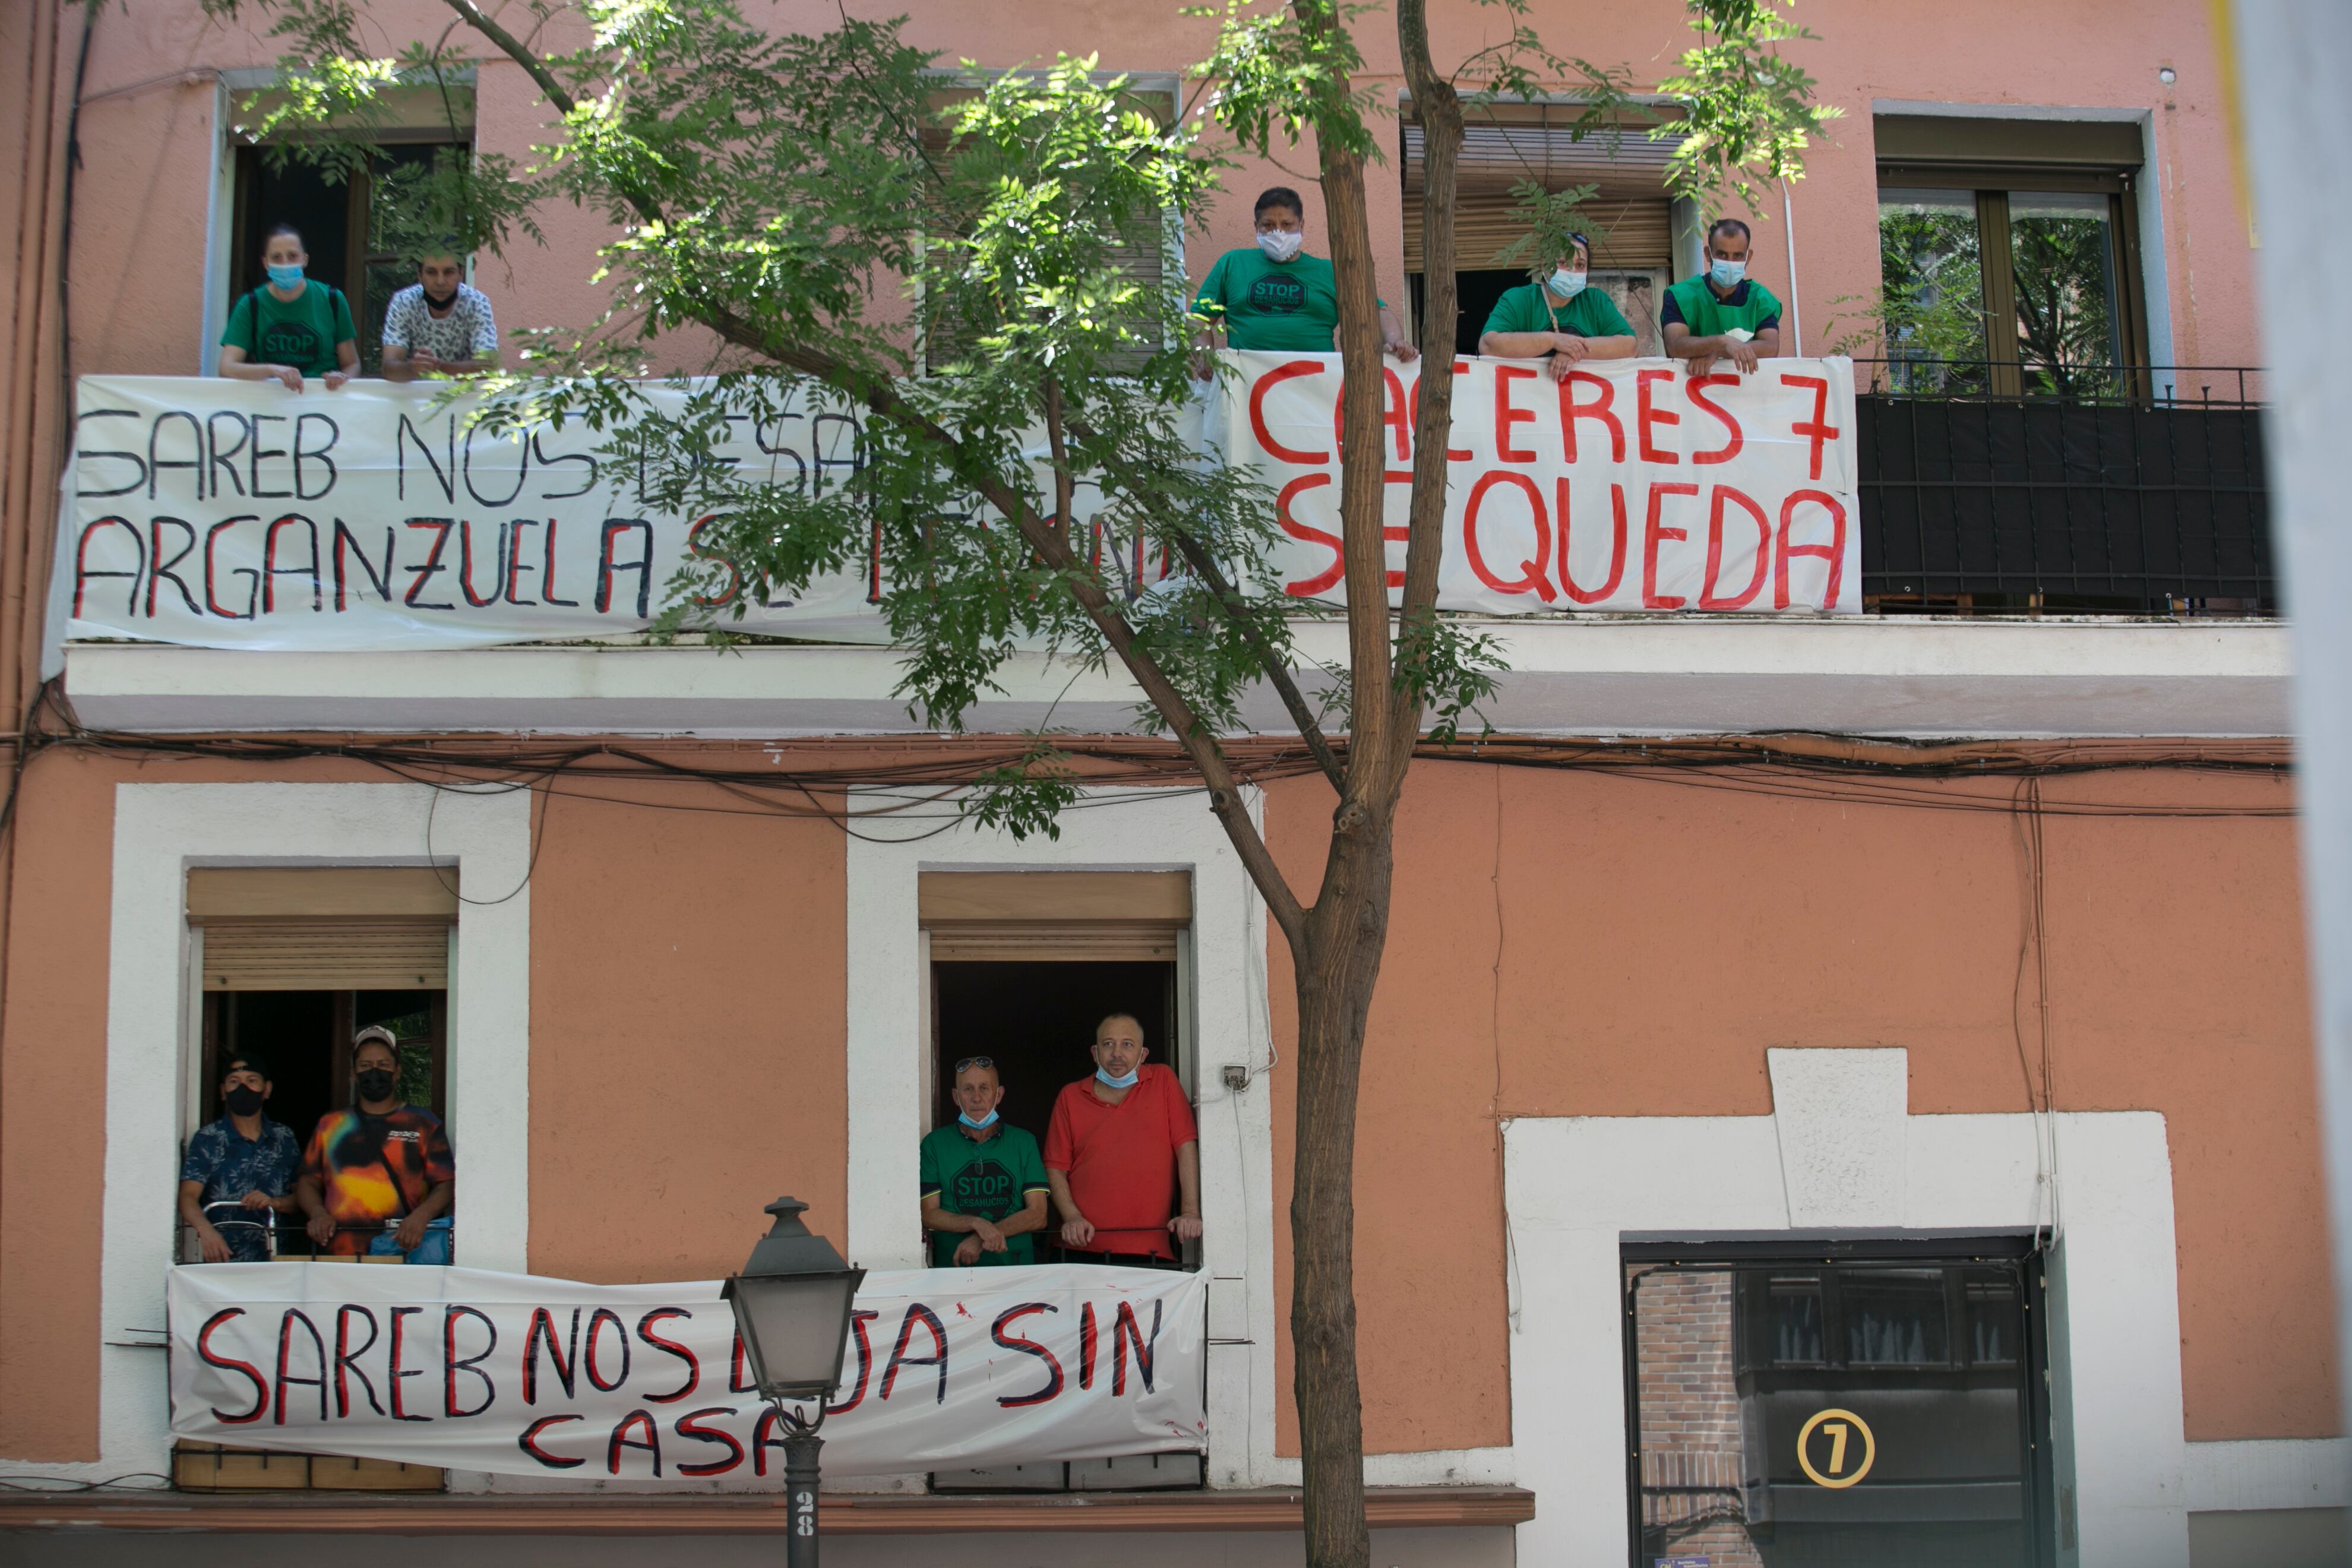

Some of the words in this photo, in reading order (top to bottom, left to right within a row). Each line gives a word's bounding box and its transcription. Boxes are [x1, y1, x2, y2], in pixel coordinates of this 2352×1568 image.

[1254, 296, 1299, 304] DESAHUCIOS
[1255, 282, 1300, 296] STOP
[265, 334, 314, 353] STOP
[1781, 373, 1839, 480] 7
[77, 409, 339, 501] SAREB
[397, 410, 598, 508] NOS
[1463, 469, 1847, 610] QUEDA
[72, 513, 653, 620] ARGANZUELA
[958, 1175, 1009, 1196] STOP
[959, 1197, 1009, 1207] DESAHUCIOS
[197, 1304, 497, 1425] SAREB
[522, 1306, 700, 1406] NOS
[991, 1298, 1162, 1408] SIN
[1823, 1424, 1847, 1473] 7
